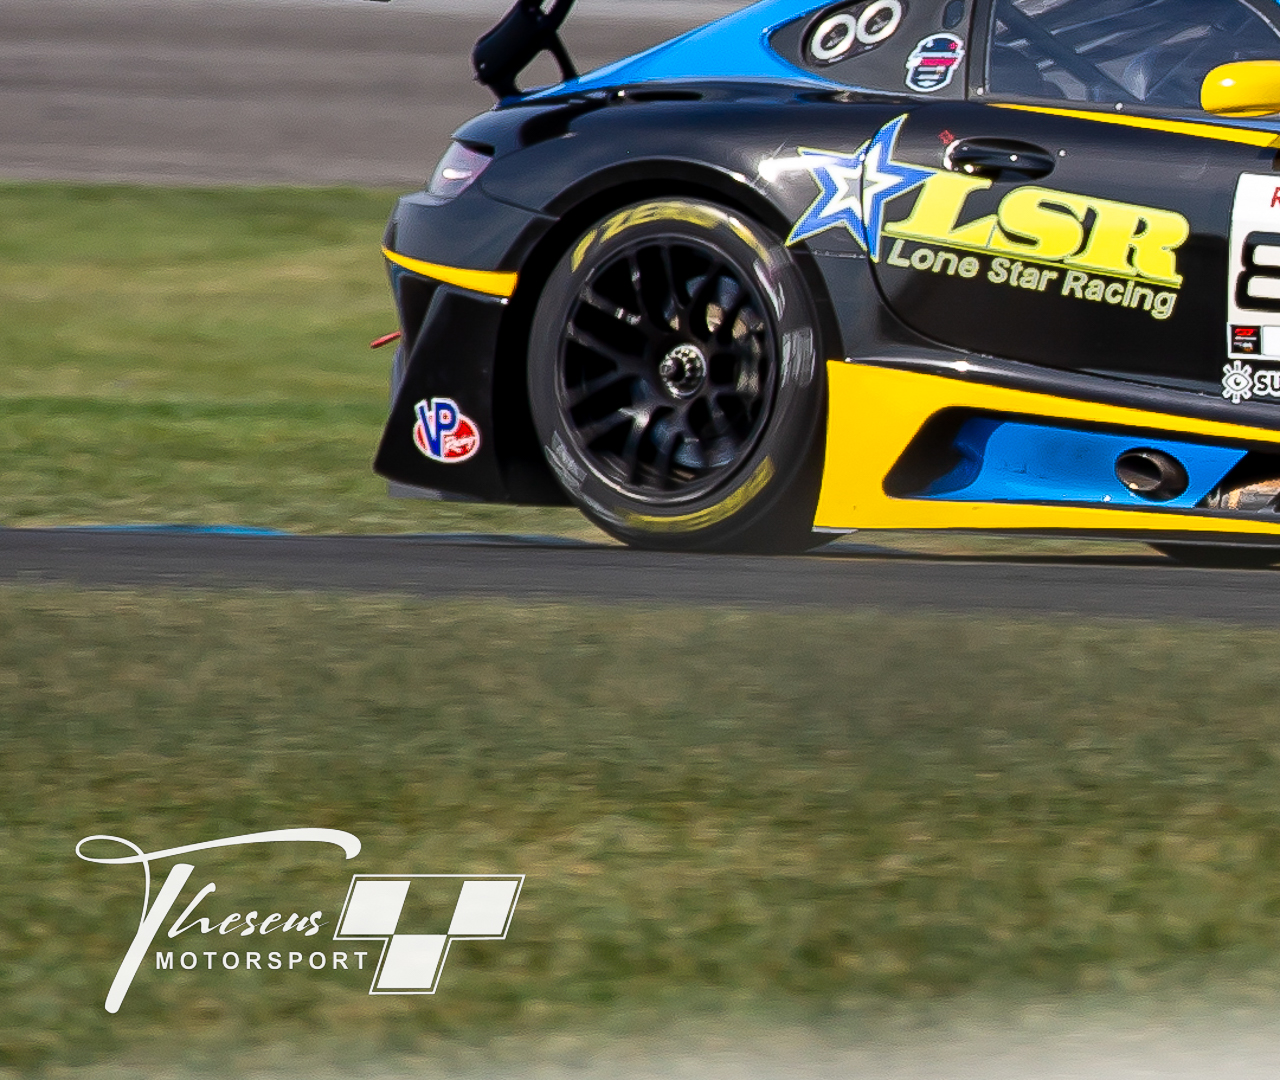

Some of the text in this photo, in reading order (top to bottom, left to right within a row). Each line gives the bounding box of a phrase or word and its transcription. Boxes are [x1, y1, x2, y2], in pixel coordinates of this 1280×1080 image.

[884, 170, 1190, 278] LSR
[886, 238, 1179, 320] Lone Star Racing
[414, 397, 459, 459] VP
